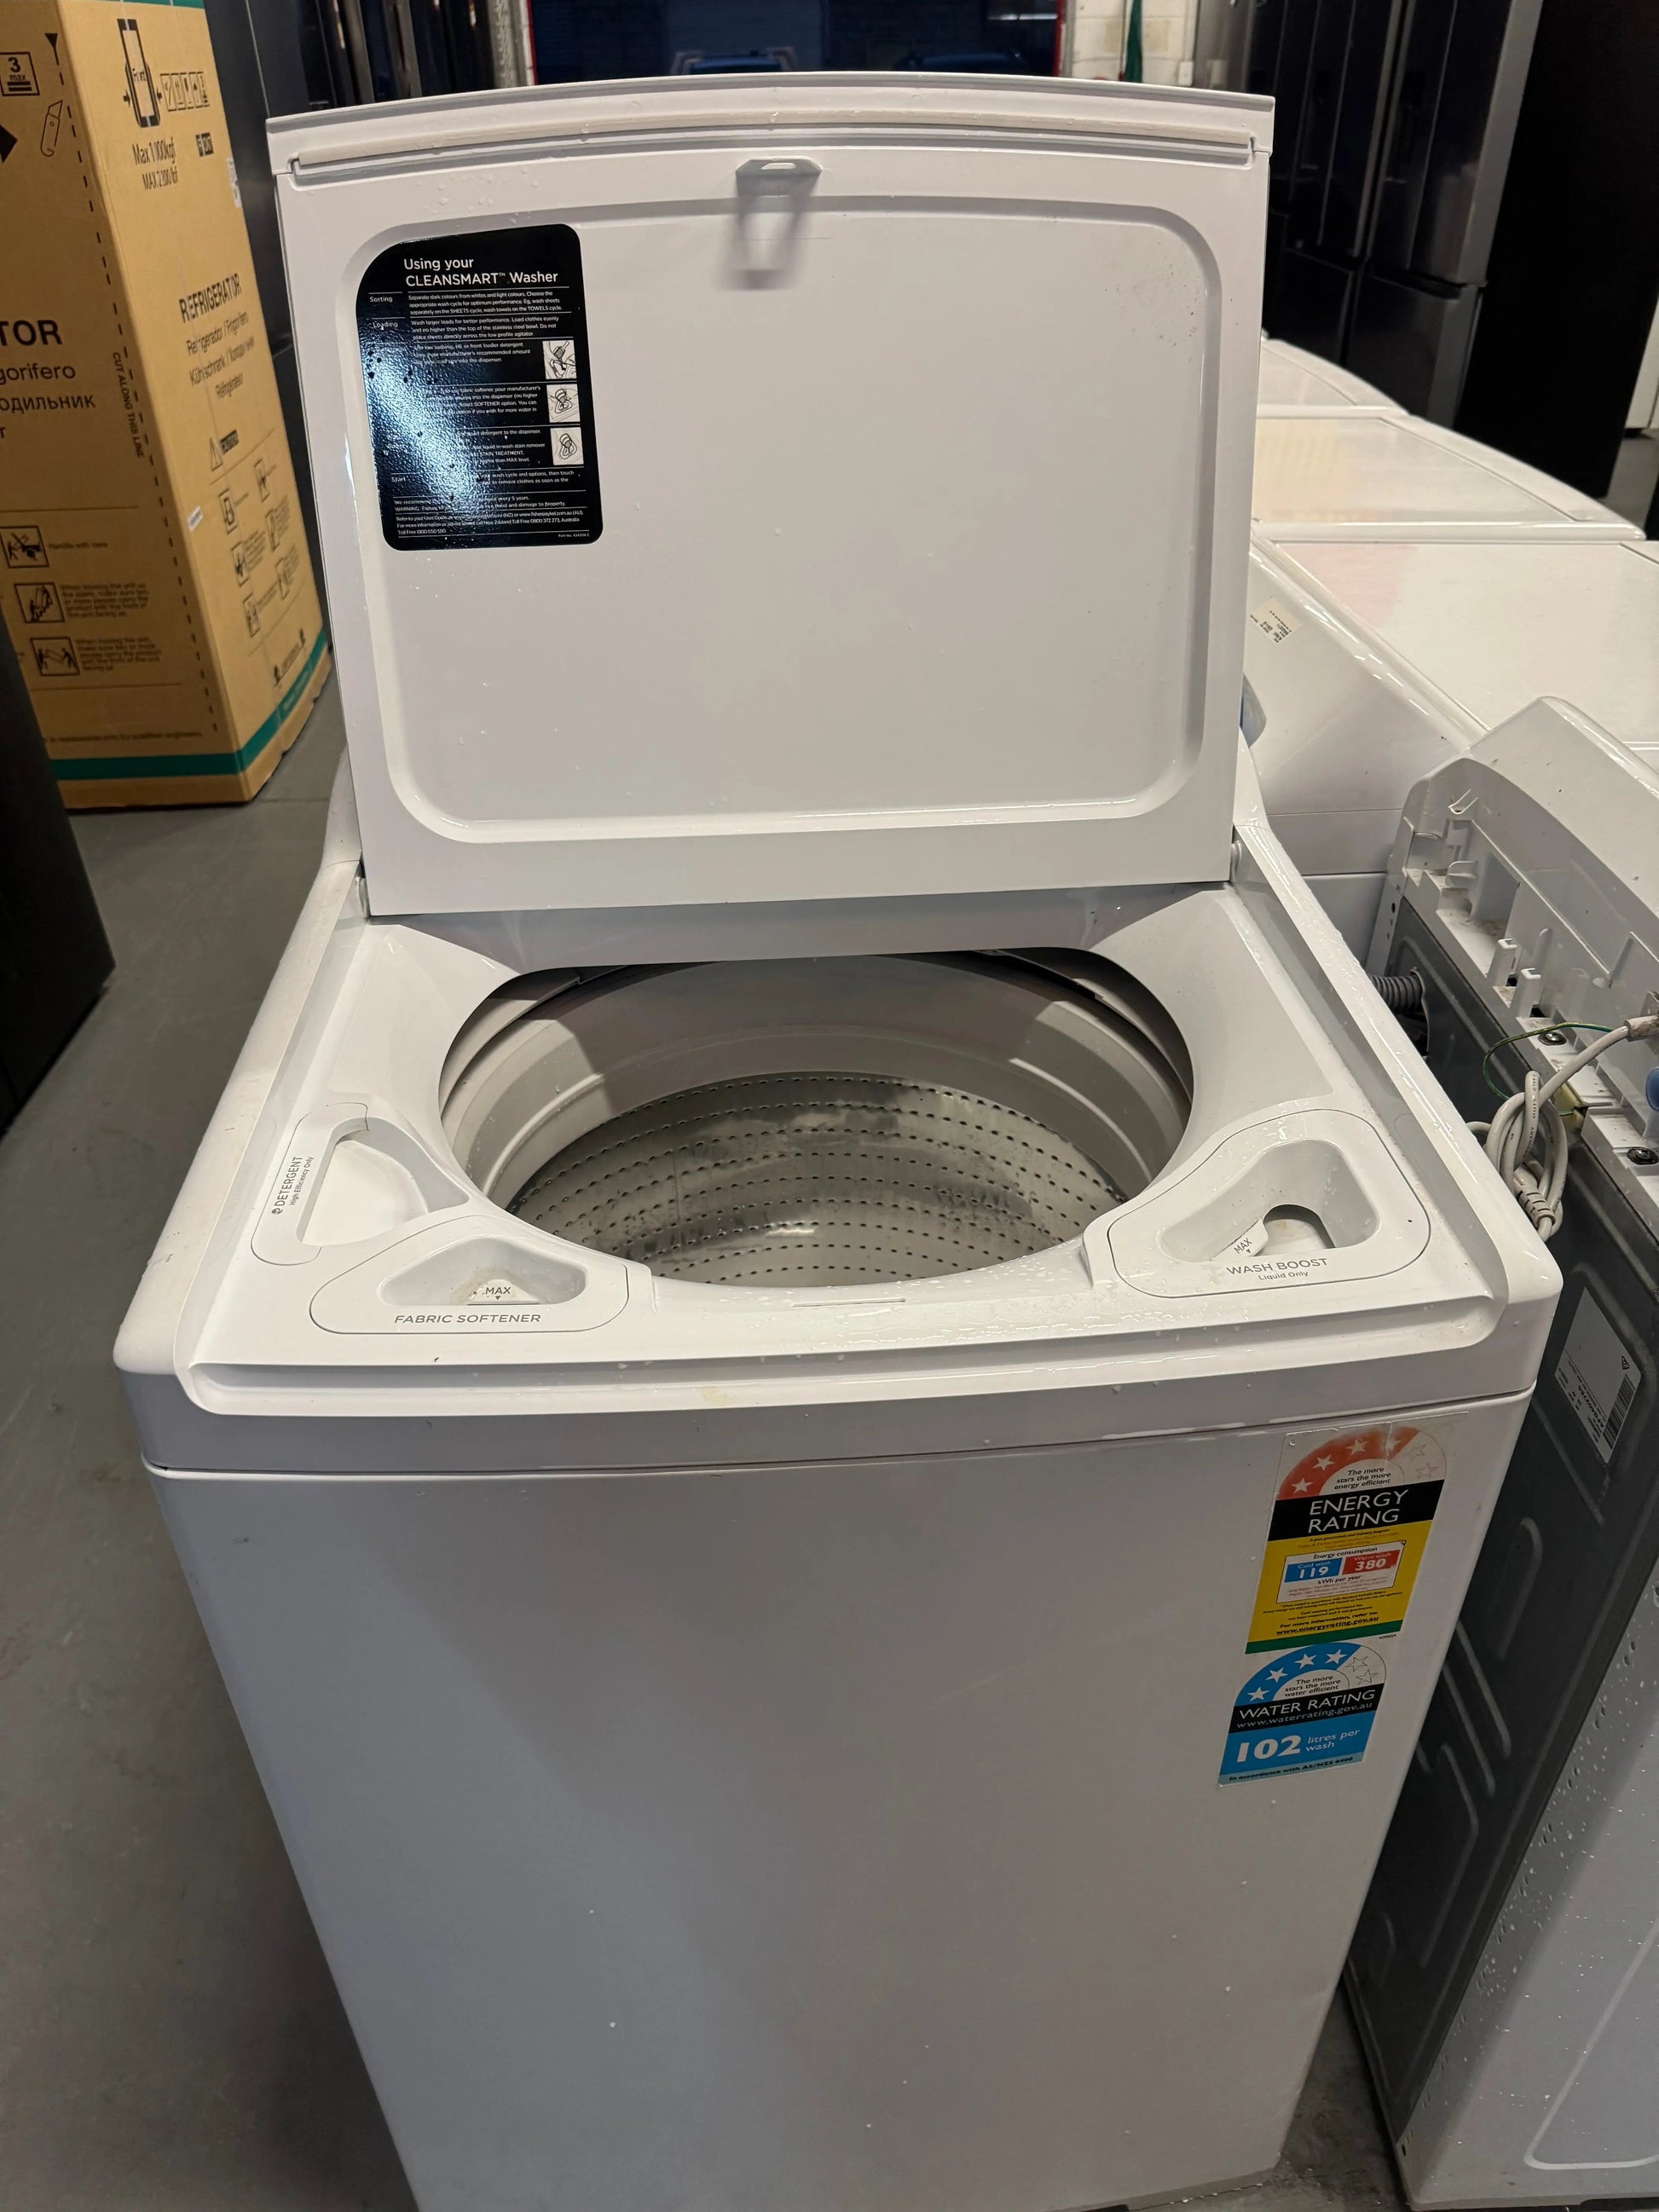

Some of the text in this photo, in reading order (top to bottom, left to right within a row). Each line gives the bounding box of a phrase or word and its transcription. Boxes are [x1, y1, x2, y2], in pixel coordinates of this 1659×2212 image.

[8, 57, 21, 72] 3
[132, 143, 149, 165] Max
[404, 258, 474, 271] Using your
[509, 271, 558, 284] Washer
[179, 273, 242, 323] REFRIGERATOR
[0, 320, 62, 346] TOR
[113, 352, 145, 458] CUT ALONG THIS LINE
[275, 1156, 303, 1206] DETERGENT
[289, 1193, 299, 1205] High
[303, 1156, 315, 1169] Only
[1234, 1238, 1252, 1254] MAX
[1226, 1257, 1328, 1275] WASH BOOST
[1258, 1272, 1286, 1280] Liquid
[485, 1286, 512, 1295] MAX
[395, 1314, 542, 1324] FABRIC SOFTENER
[1361, 1478, 1391, 1487] efficient
[1309, 1489, 1409, 1516] ENERGY
[1308, 1508, 1400, 1533] RATING
[1337, 1546, 1378, 1556] consumption
[1298, 1558, 1388, 1580] 119 380
[1275, 1616, 1379, 1636] www.energyrating.gov.au
[1310, 1614, 1351, 1626] information,
[1309, 1684, 1339, 1694] efficient
[1239, 1689, 1376, 1719] WATER RATING
[1236, 1701, 1373, 1729] www.waterrating.gov.au
[1236, 1730, 1361, 1763] 102 litres per
[1305, 1741, 1335, 1752] wash
[1238, 1770, 1281, 1779] accordance
[1302, 1760, 1333, 1770] AS/NZS
